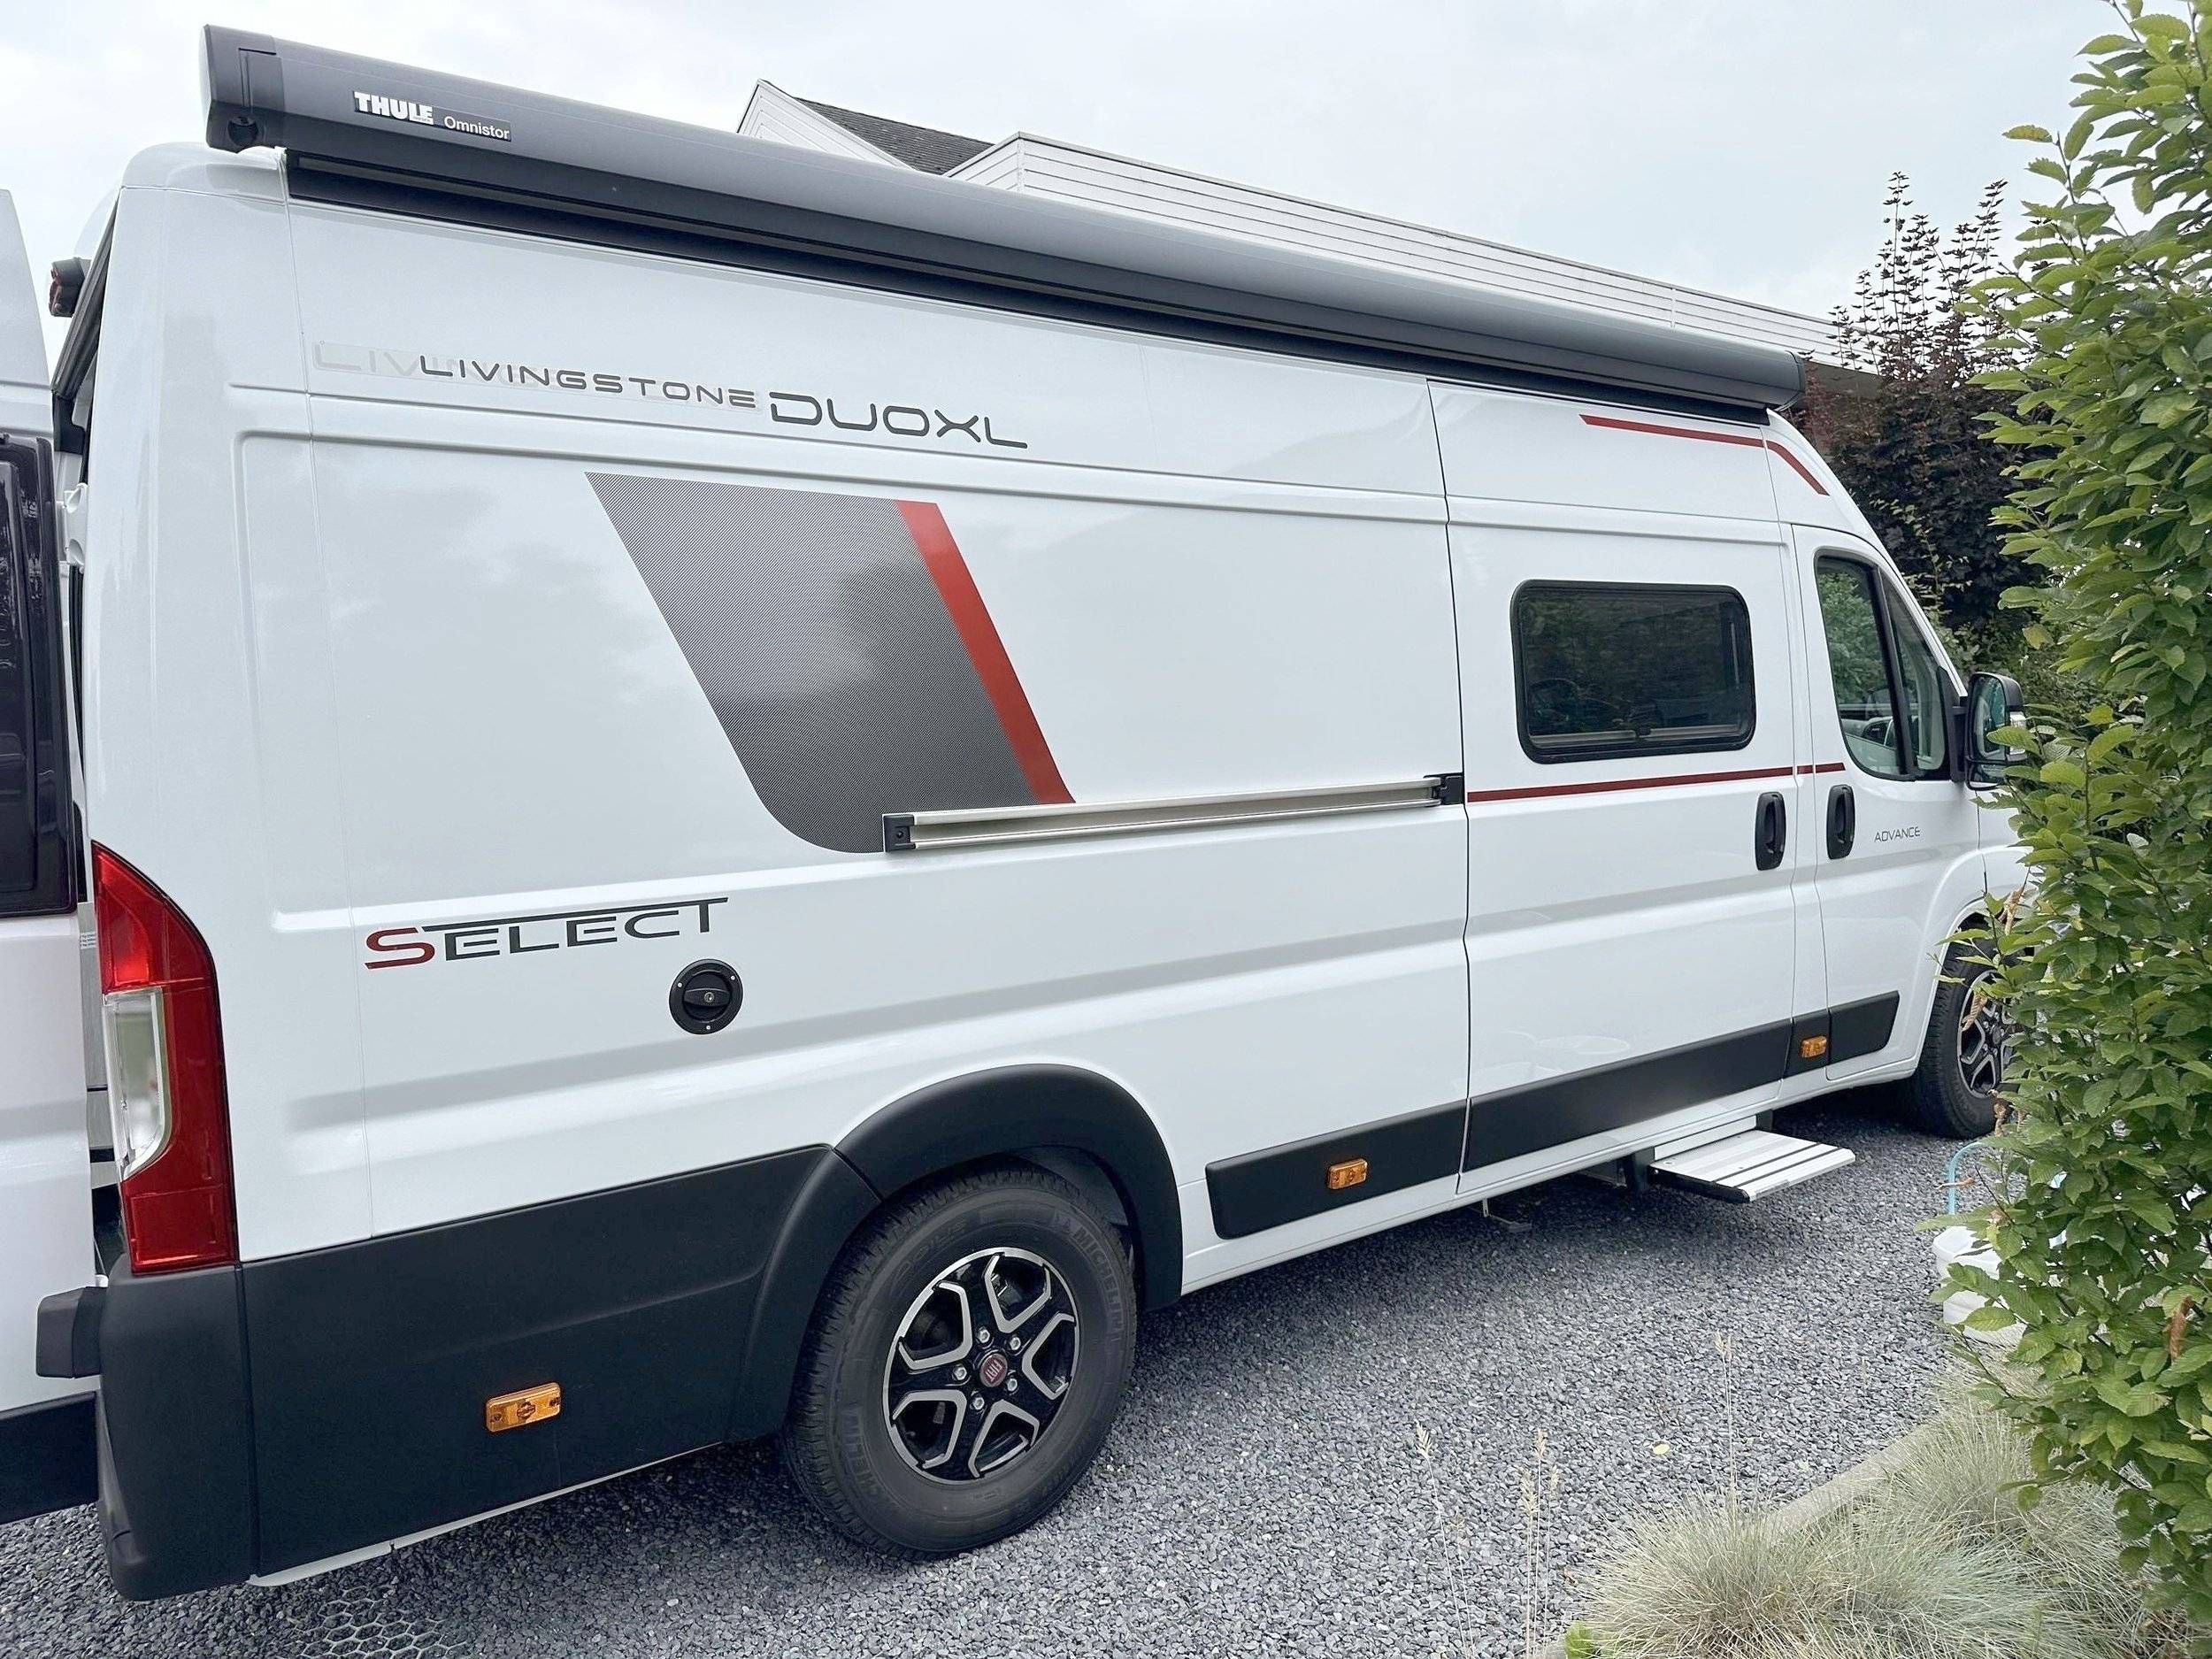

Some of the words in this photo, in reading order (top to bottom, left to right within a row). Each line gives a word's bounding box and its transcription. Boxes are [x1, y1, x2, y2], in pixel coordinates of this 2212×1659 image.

[354, 91, 434, 126] THULE
[443, 116, 511, 140] Omnistor
[419, 355, 756, 408] LIVINGSTONE
[770, 392, 1028, 448] DUOXL
[1874, 826, 1921, 842] ADVANCE
[365, 897, 728, 970] SELECT
[1071, 1225, 1125, 1333] MICHELIN
[985, 1359, 1003, 1382] FIAT
